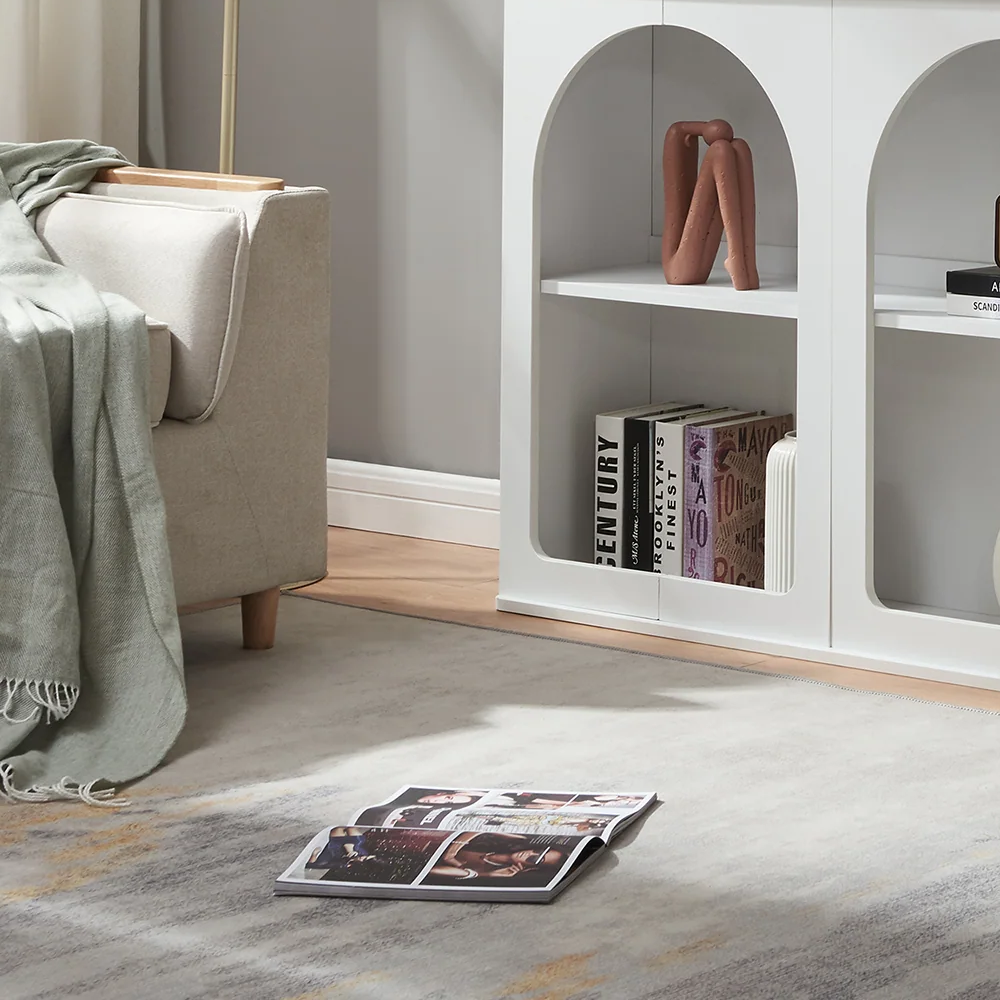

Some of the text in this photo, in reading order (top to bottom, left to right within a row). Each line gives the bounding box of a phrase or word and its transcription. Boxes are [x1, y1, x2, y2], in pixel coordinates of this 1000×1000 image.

[596, 435, 619, 567] CENTURY
[666, 470, 677, 550] FINEST
[713, 474, 764, 523] TONGUE
